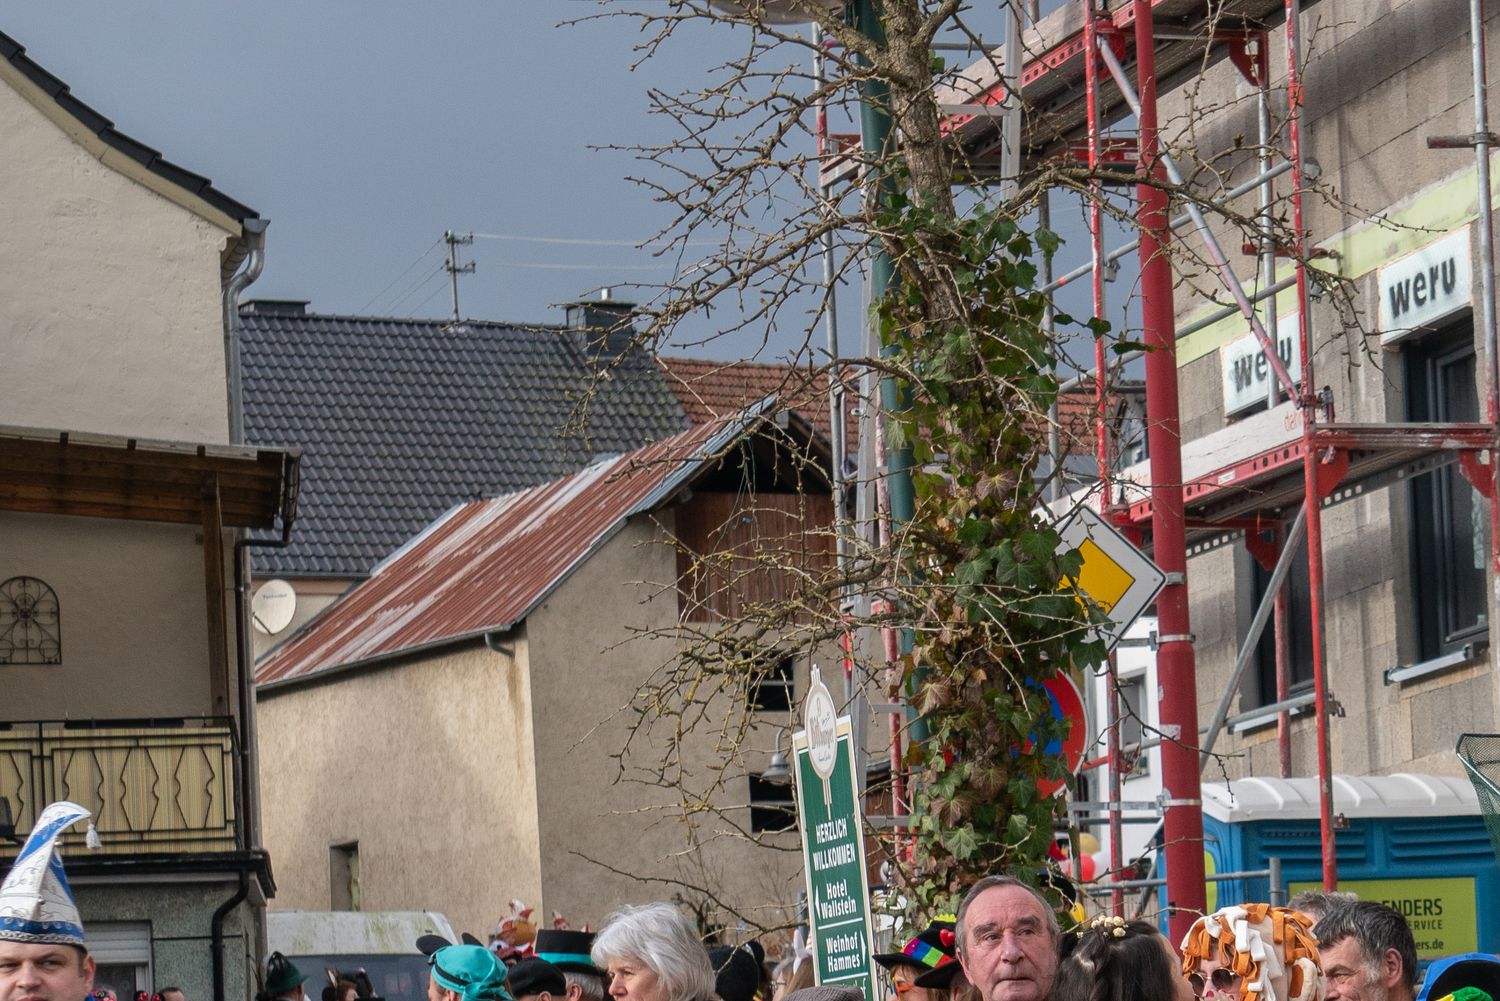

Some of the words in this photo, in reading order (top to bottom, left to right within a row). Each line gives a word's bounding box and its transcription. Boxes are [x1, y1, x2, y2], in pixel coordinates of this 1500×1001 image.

[1389, 257, 1456, 319] weru
[1234, 336, 1292, 393] weu
[816, 820, 848, 845] HERZLICH
[813, 843, 856, 872] WILLKOMMEN
[826, 879, 848, 900] Hotel
[821, 898, 857, 920] Wallstein
[826, 931, 858, 954] Weinhof
[827, 953, 861, 973] Hammes
